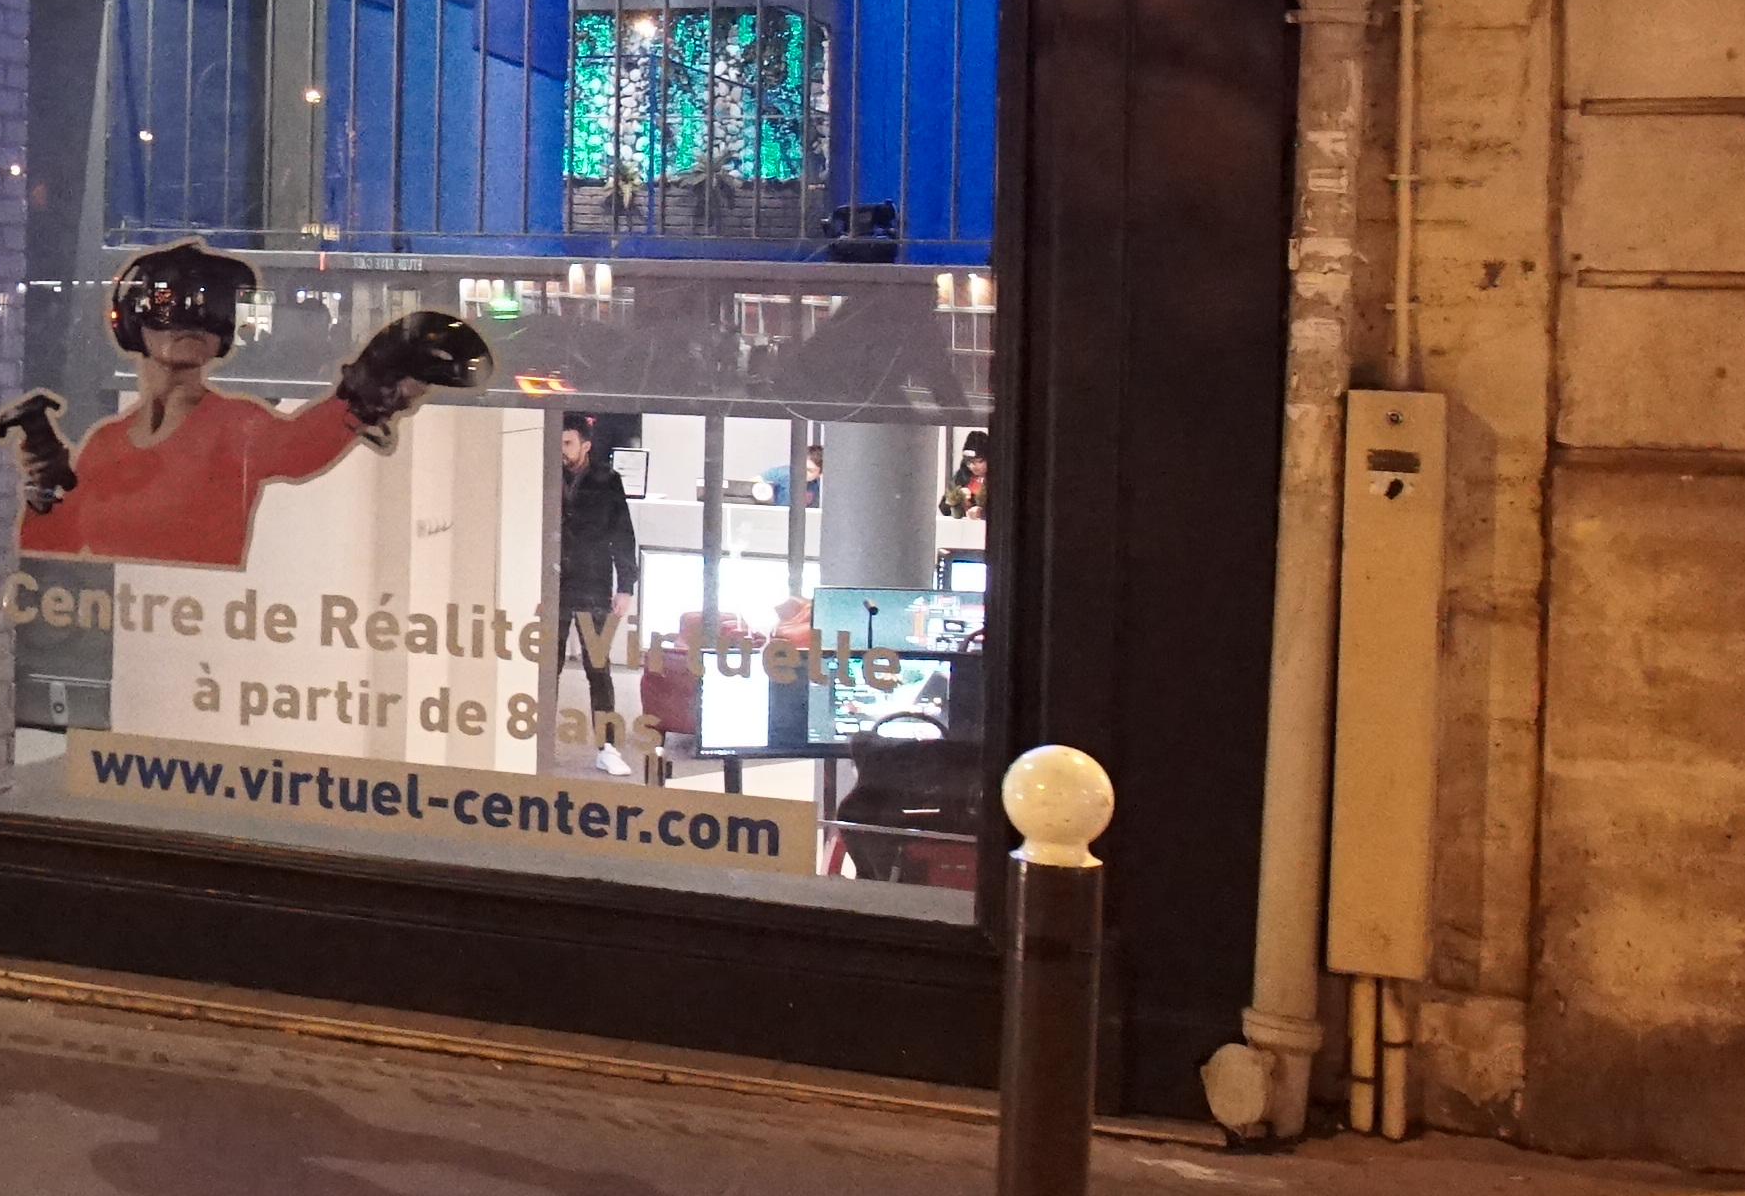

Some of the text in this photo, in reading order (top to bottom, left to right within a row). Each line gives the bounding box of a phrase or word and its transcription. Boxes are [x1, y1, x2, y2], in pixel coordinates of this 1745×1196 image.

[3, 571, 902, 691] Centre de Réalité Virtuelle
[191, 662, 662, 756] à partir de 8 ans
[92, 749, 781, 857] www.virtuel-center.com
